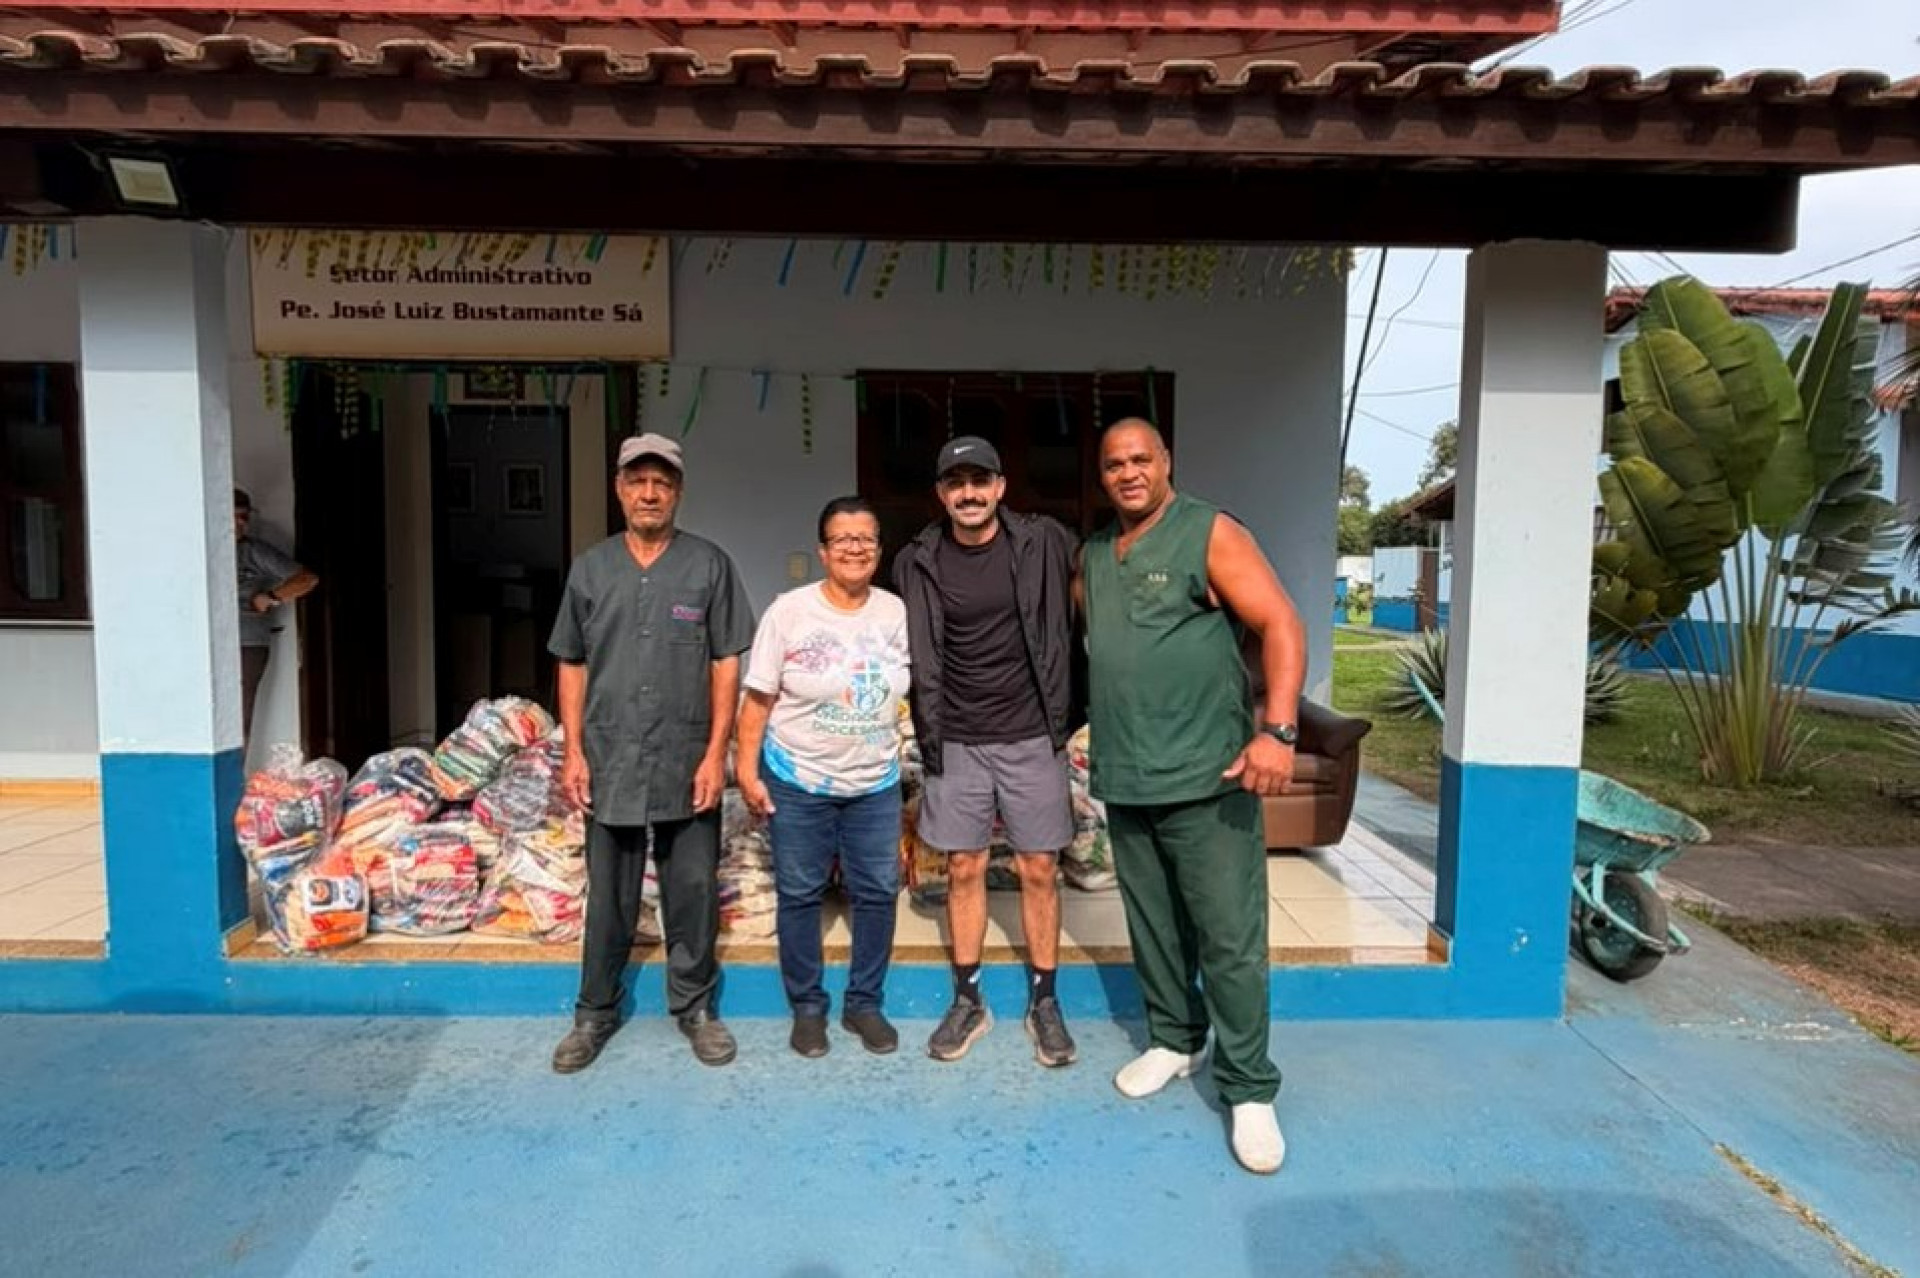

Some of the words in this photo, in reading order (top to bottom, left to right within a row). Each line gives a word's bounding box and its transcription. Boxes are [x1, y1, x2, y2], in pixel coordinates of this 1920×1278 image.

[329, 264, 397, 286] Setor
[406, 264, 592, 286] Administrativo
[281, 299, 319, 319] Pe.
[327, 299, 386, 320] José
[394, 301, 445, 320] Luiz
[453, 302, 604, 322] Bustamante
[612, 302, 643, 323] Sá
